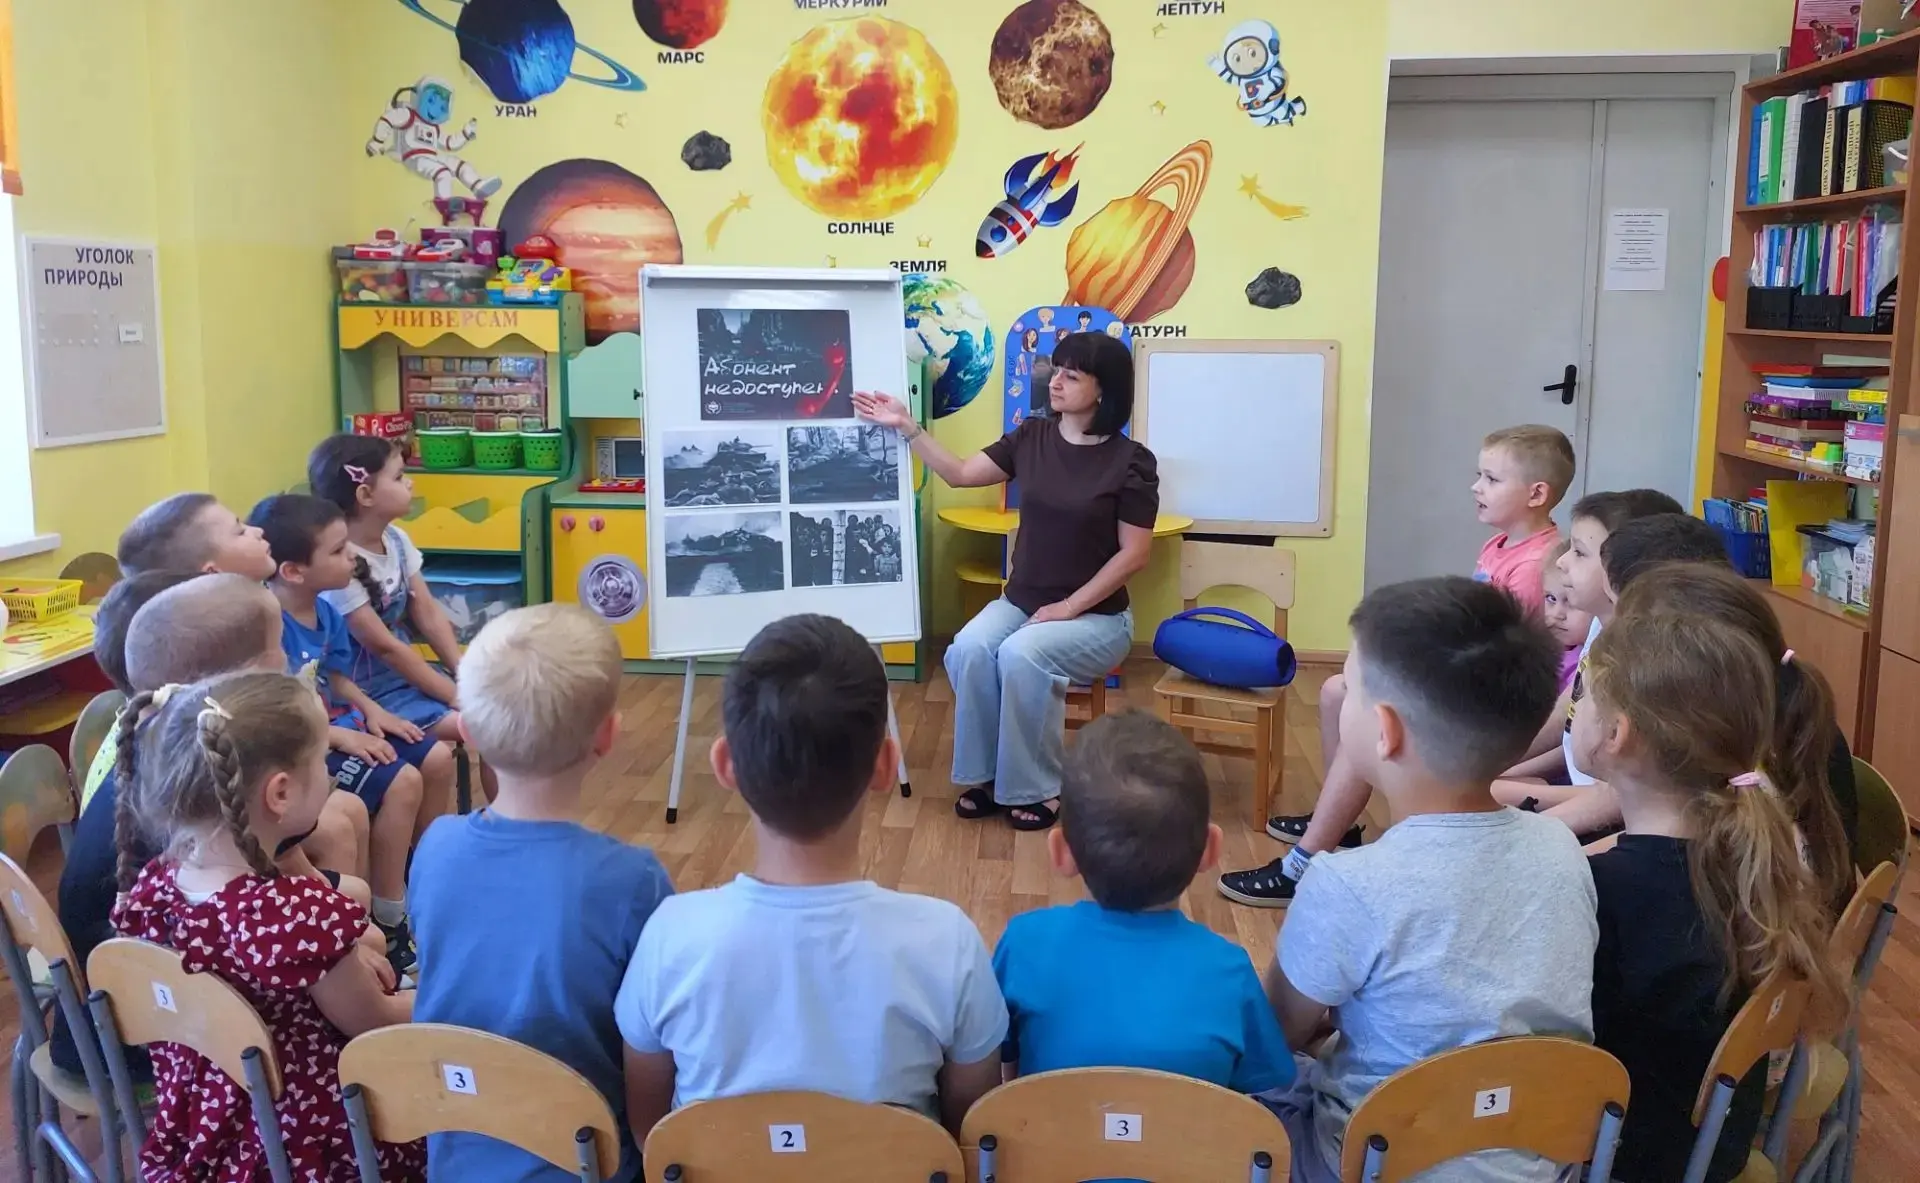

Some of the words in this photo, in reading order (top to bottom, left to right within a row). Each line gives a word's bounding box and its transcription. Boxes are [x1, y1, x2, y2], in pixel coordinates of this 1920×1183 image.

[1156, 1, 1225, 16] НЕПТУН
[658, 51, 705, 64] МАРС
[495, 105, 537, 117] УРАН
[1822, 112, 1834, 195] ДОКУМЕНТАЦИЯ
[828, 222, 894, 236] СОЛНЦЕ
[75, 247, 135, 264] УГОЛОК
[889, 260, 947, 272] ЗЕМЛЯ
[44, 268, 123, 290] ПРИРОДЫ
[374, 309, 519, 328] УНИВЕРСАМ
[1126, 325, 1187, 338] АТУРН
[704, 356, 797, 377] Абонент
[159, 989, 168, 1005] 3
[453, 1071, 466, 1089] 3
[1483, 1093, 1496, 1110] 3
[1116, 1119, 1129, 1137] 3
[780, 1130, 795, 1148] 2
